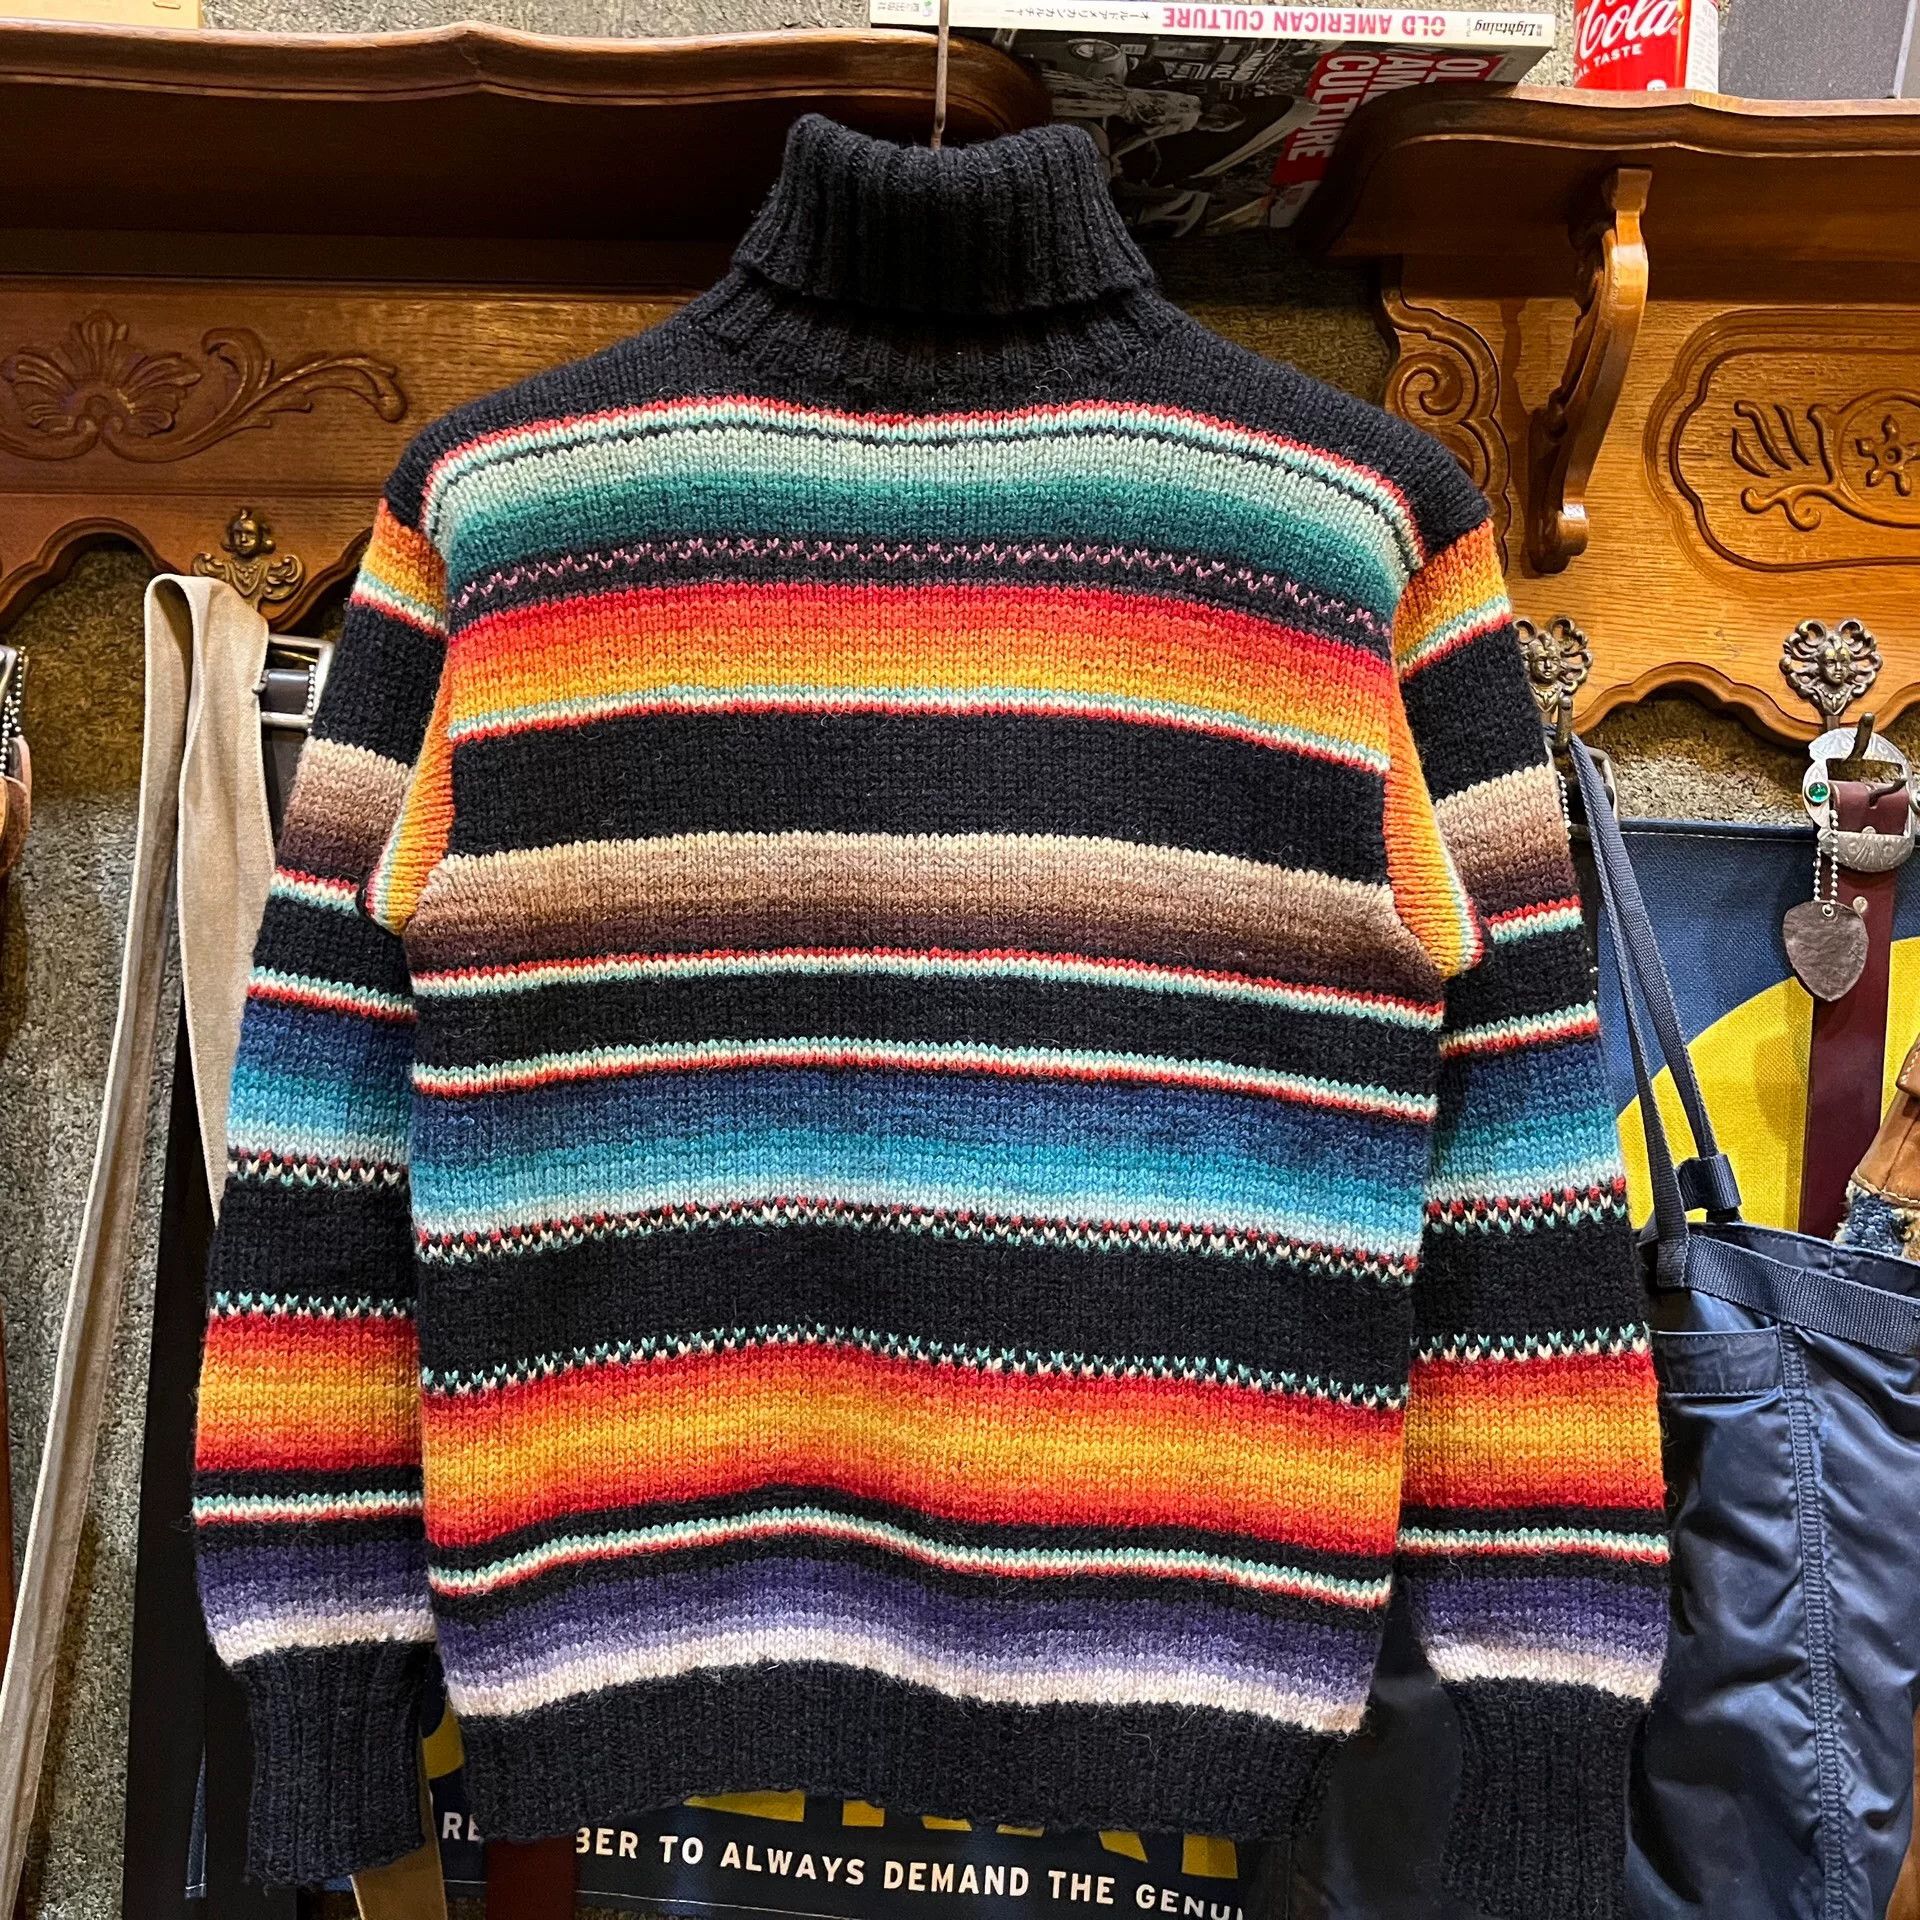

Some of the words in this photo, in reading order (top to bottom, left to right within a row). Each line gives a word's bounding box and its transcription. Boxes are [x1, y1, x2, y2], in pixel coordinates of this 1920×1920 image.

[1162, 7, 1264, 33] CULTURE
[1269, 11, 1393, 35] AMERICAN
[1401, 15, 1446, 37] OLD
[1473, 19, 1536, 37] Lightning
[1593, 44, 1642, 66] TASTE
[1424, 58, 1489, 84] OL
[1287, 55, 1380, 162] CULTURE
[659, 1835, 704, 1865] TO
[720, 1842, 865, 1885] ALWAYS
[883, 1860, 1030, 1897] DEMAND
[1048, 1869, 1115, 1905] THE
